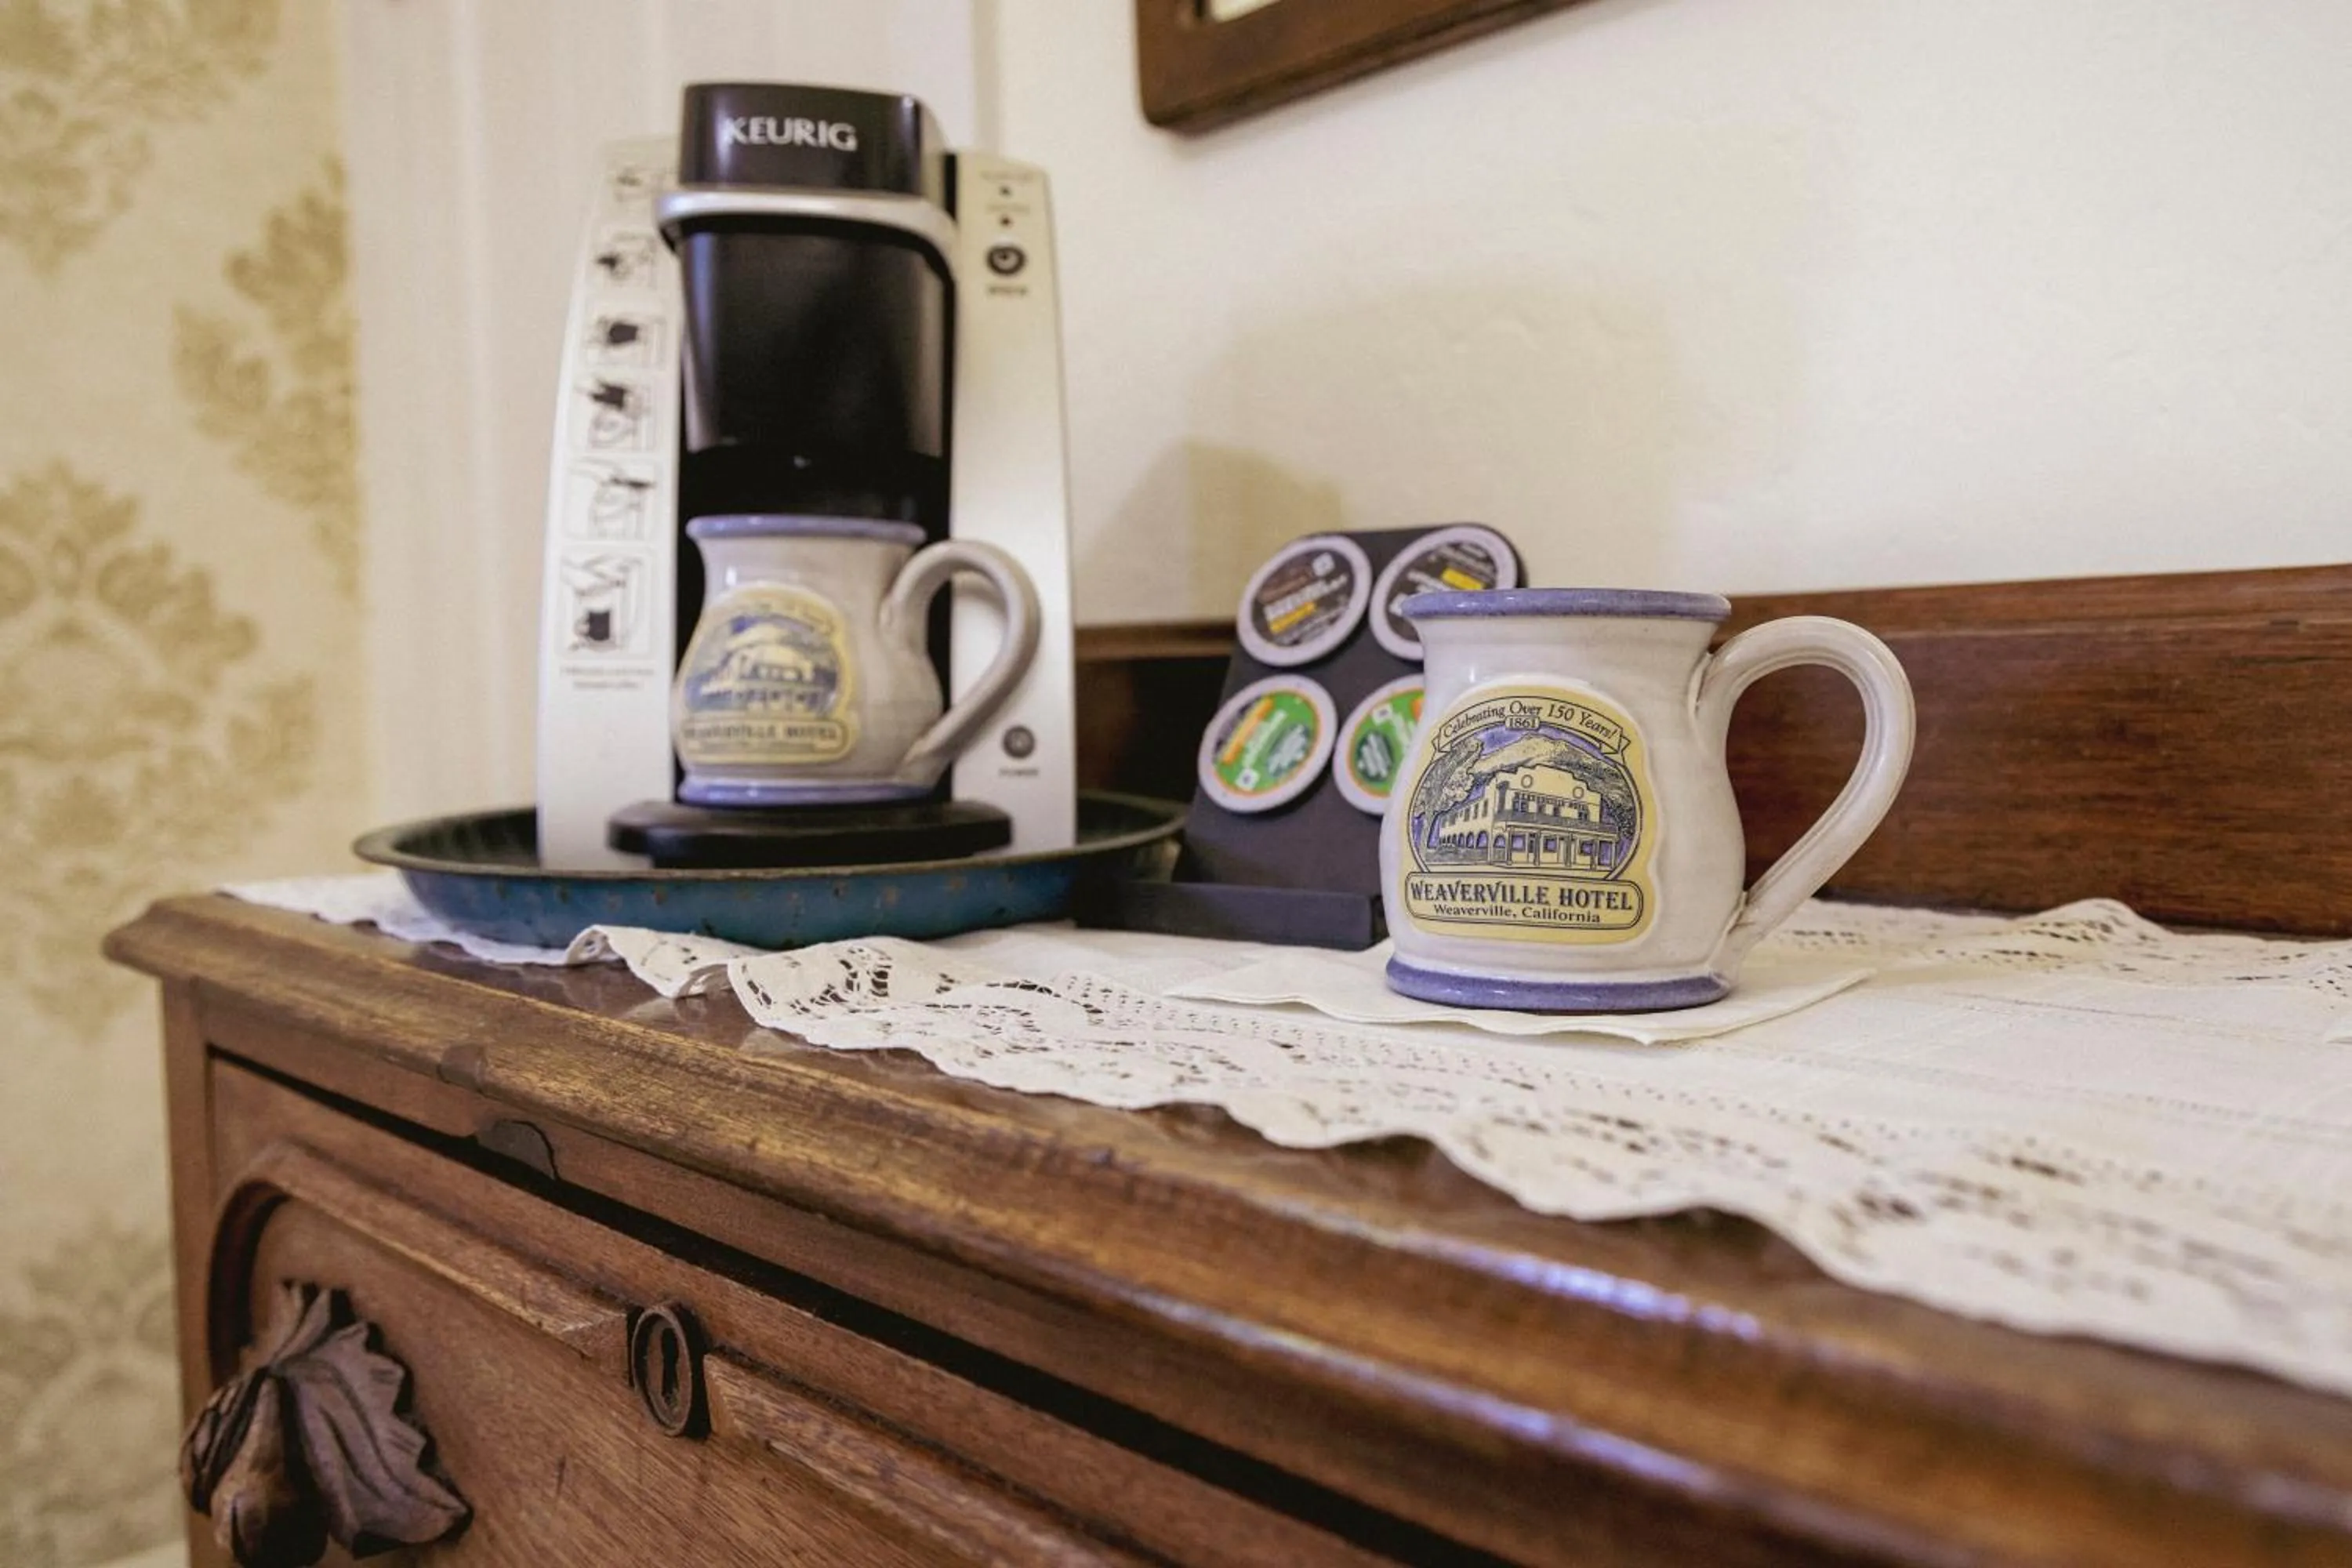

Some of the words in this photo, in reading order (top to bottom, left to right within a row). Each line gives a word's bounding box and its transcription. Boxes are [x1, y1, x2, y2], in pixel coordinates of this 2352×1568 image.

[725, 116, 858, 152] KEURIG
[1443, 706, 1505, 738] Celebrating
[1509, 700, 1542, 715] Over
[1548, 703, 1574, 721] 150
[1578, 710, 1618, 739] Years!
[1508, 717, 1537, 728] 1861
[1410, 880, 1551, 906] WEAVERVILLE
[1559, 887, 1633, 911] HOTEL
[1434, 903, 1518, 918] Weaverville,
[1522, 906, 1601, 924] California
